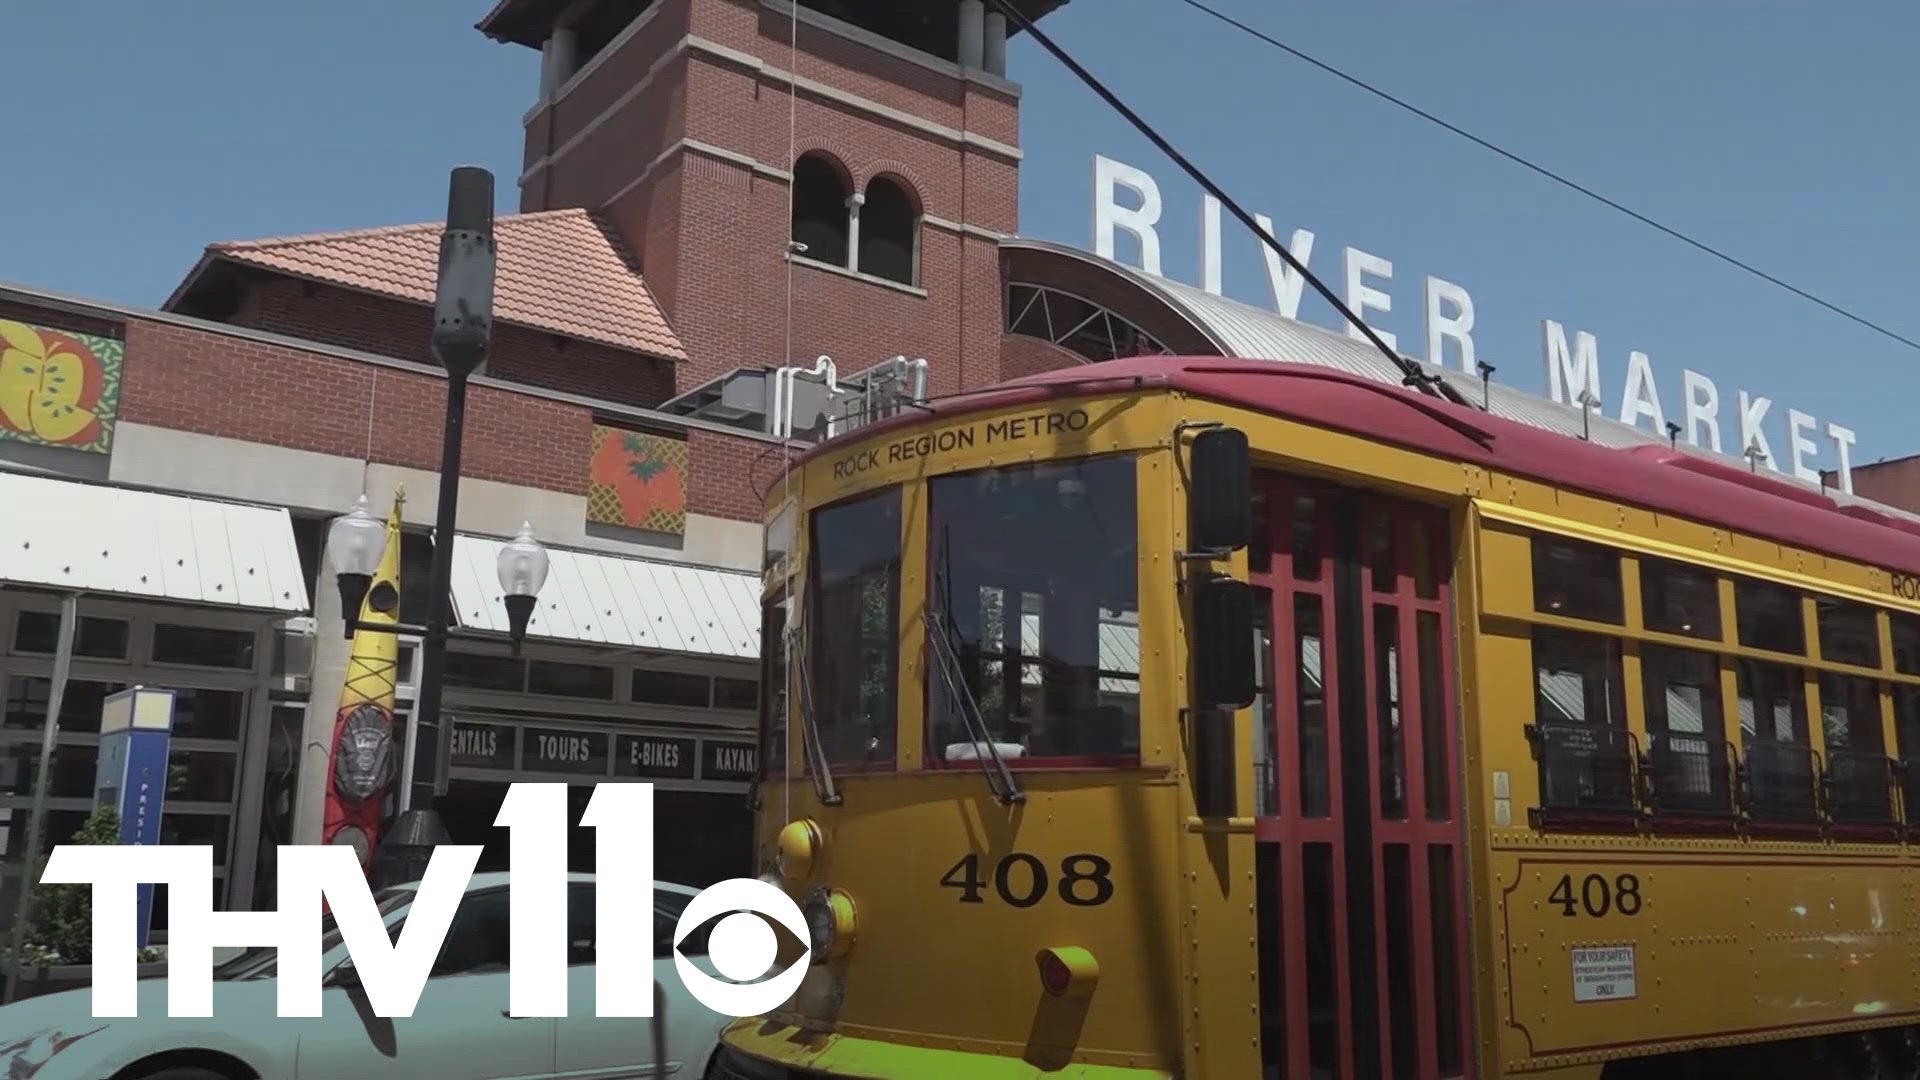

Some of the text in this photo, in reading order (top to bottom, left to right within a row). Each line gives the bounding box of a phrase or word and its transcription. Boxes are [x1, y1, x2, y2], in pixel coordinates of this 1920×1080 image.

[1093, 154, 1857, 495] RIVER MARKET
[833, 409, 1089, 480] ROCK REGION METRO
[538, 735, 590, 761] TOURS
[631, 741, 679, 767] E-BIKES
[716, 747, 757, 772] KAYAK
[940, 853, 1114, 908] 408
[1548, 873, 1642, 918] 408
